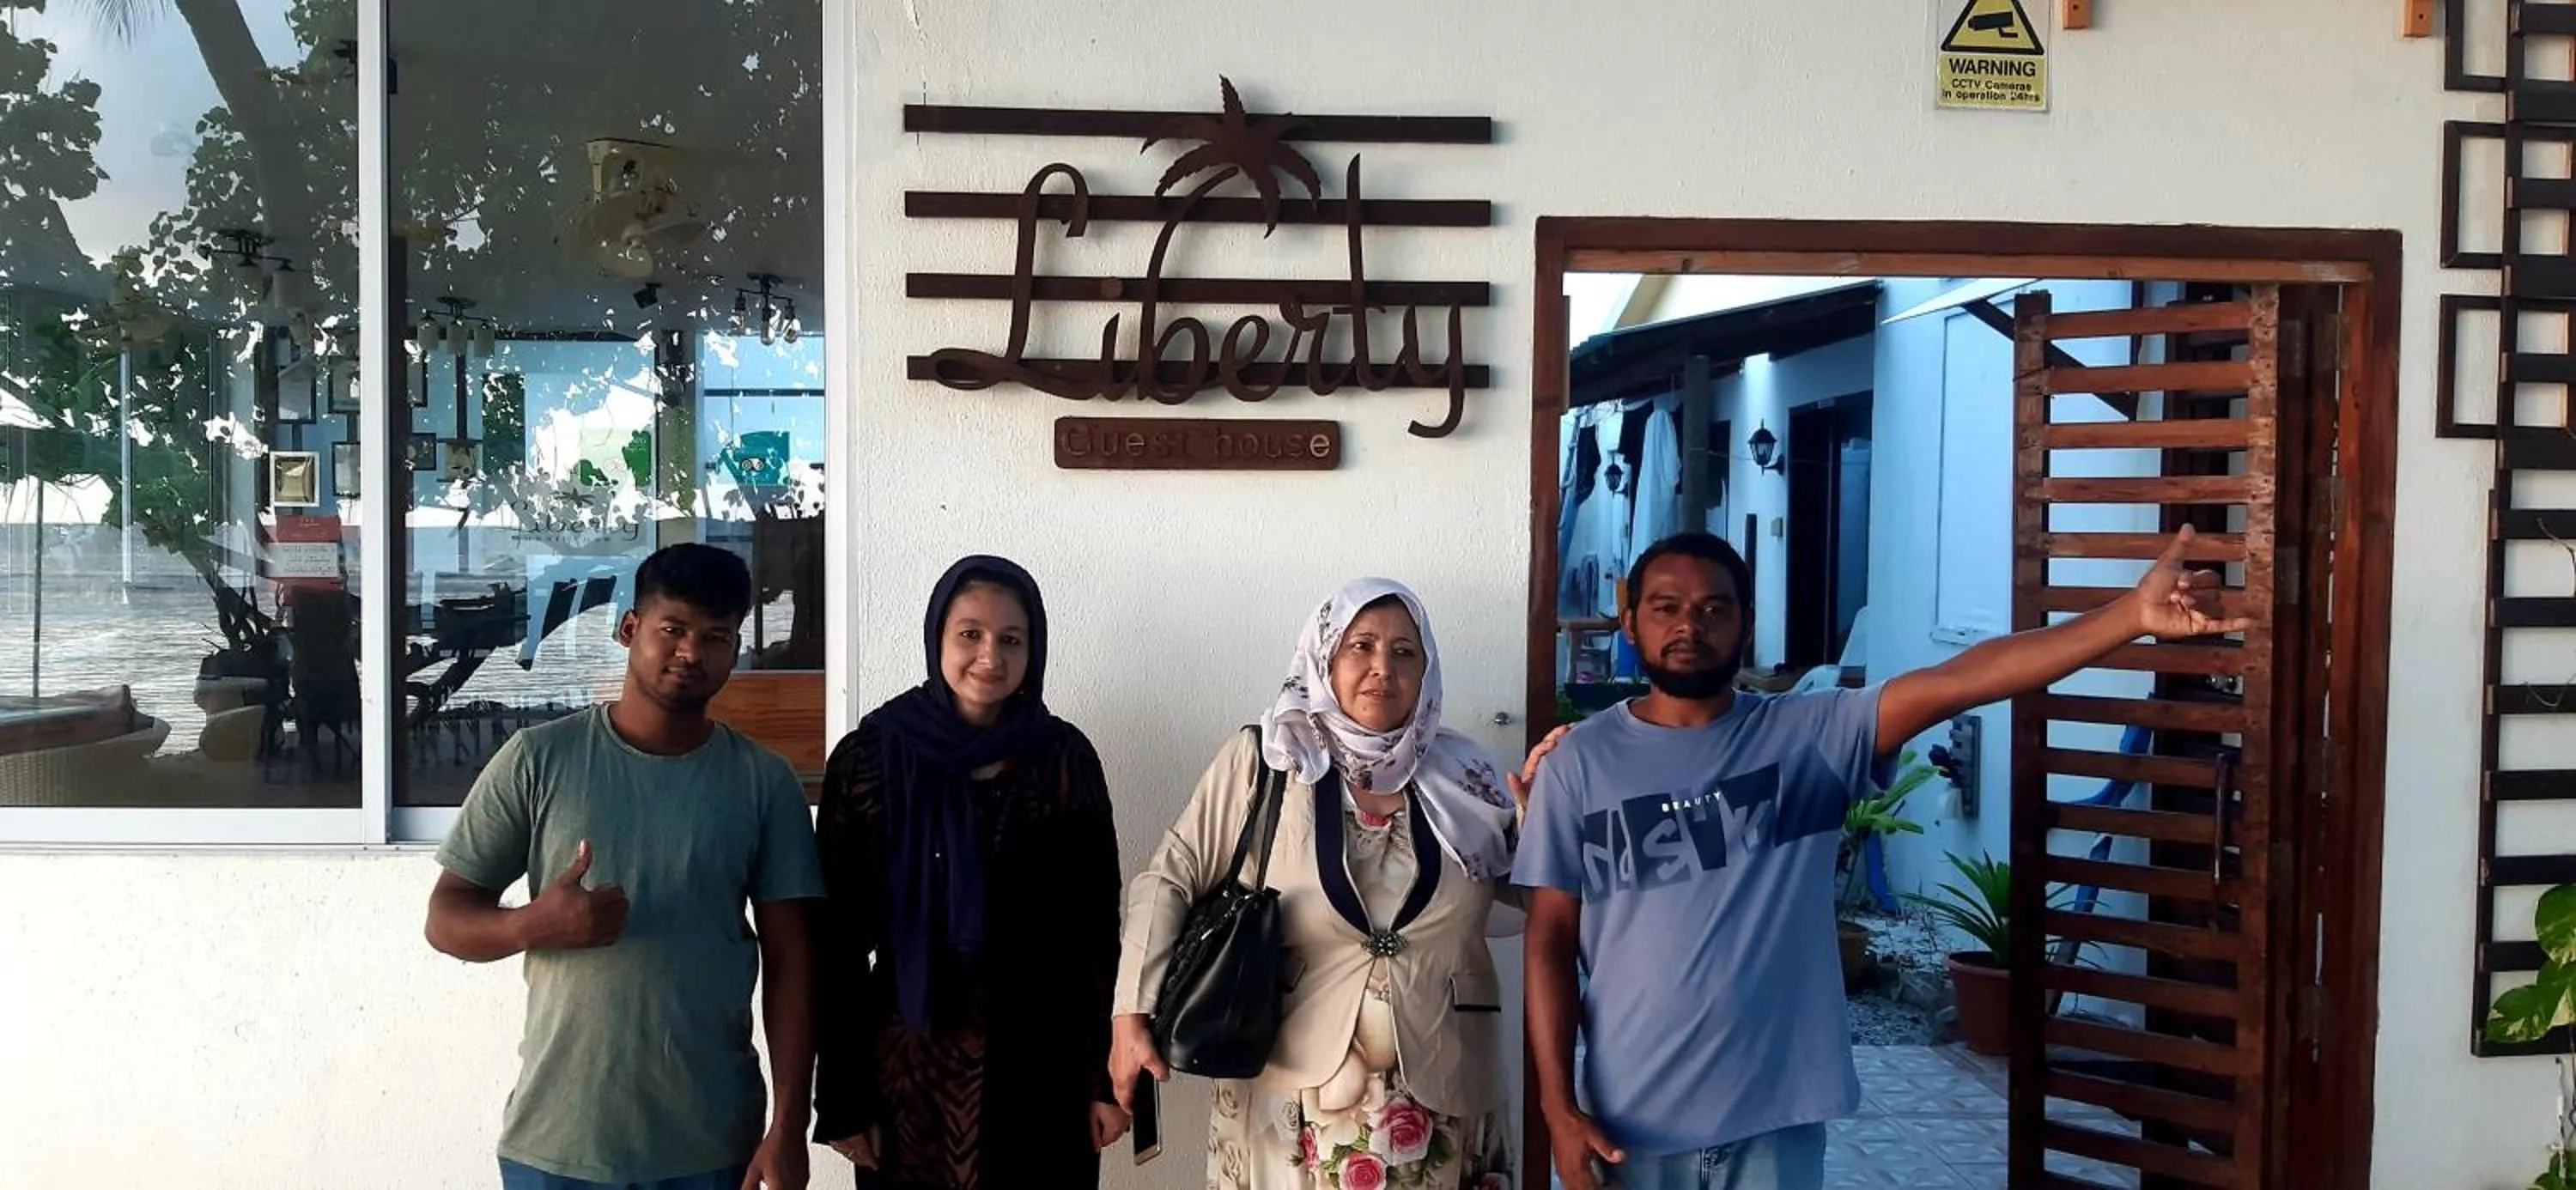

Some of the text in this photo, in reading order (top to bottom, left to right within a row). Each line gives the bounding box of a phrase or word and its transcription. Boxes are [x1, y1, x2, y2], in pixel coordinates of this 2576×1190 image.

[1948, 58, 2036, 77] WARNING
[1952, 78, 1981, 88] CCTV
[929, 154, 1465, 439] Liberty
[1212, 427, 1331, 458] house
[1662, 791, 1722, 813] BEAUTY
